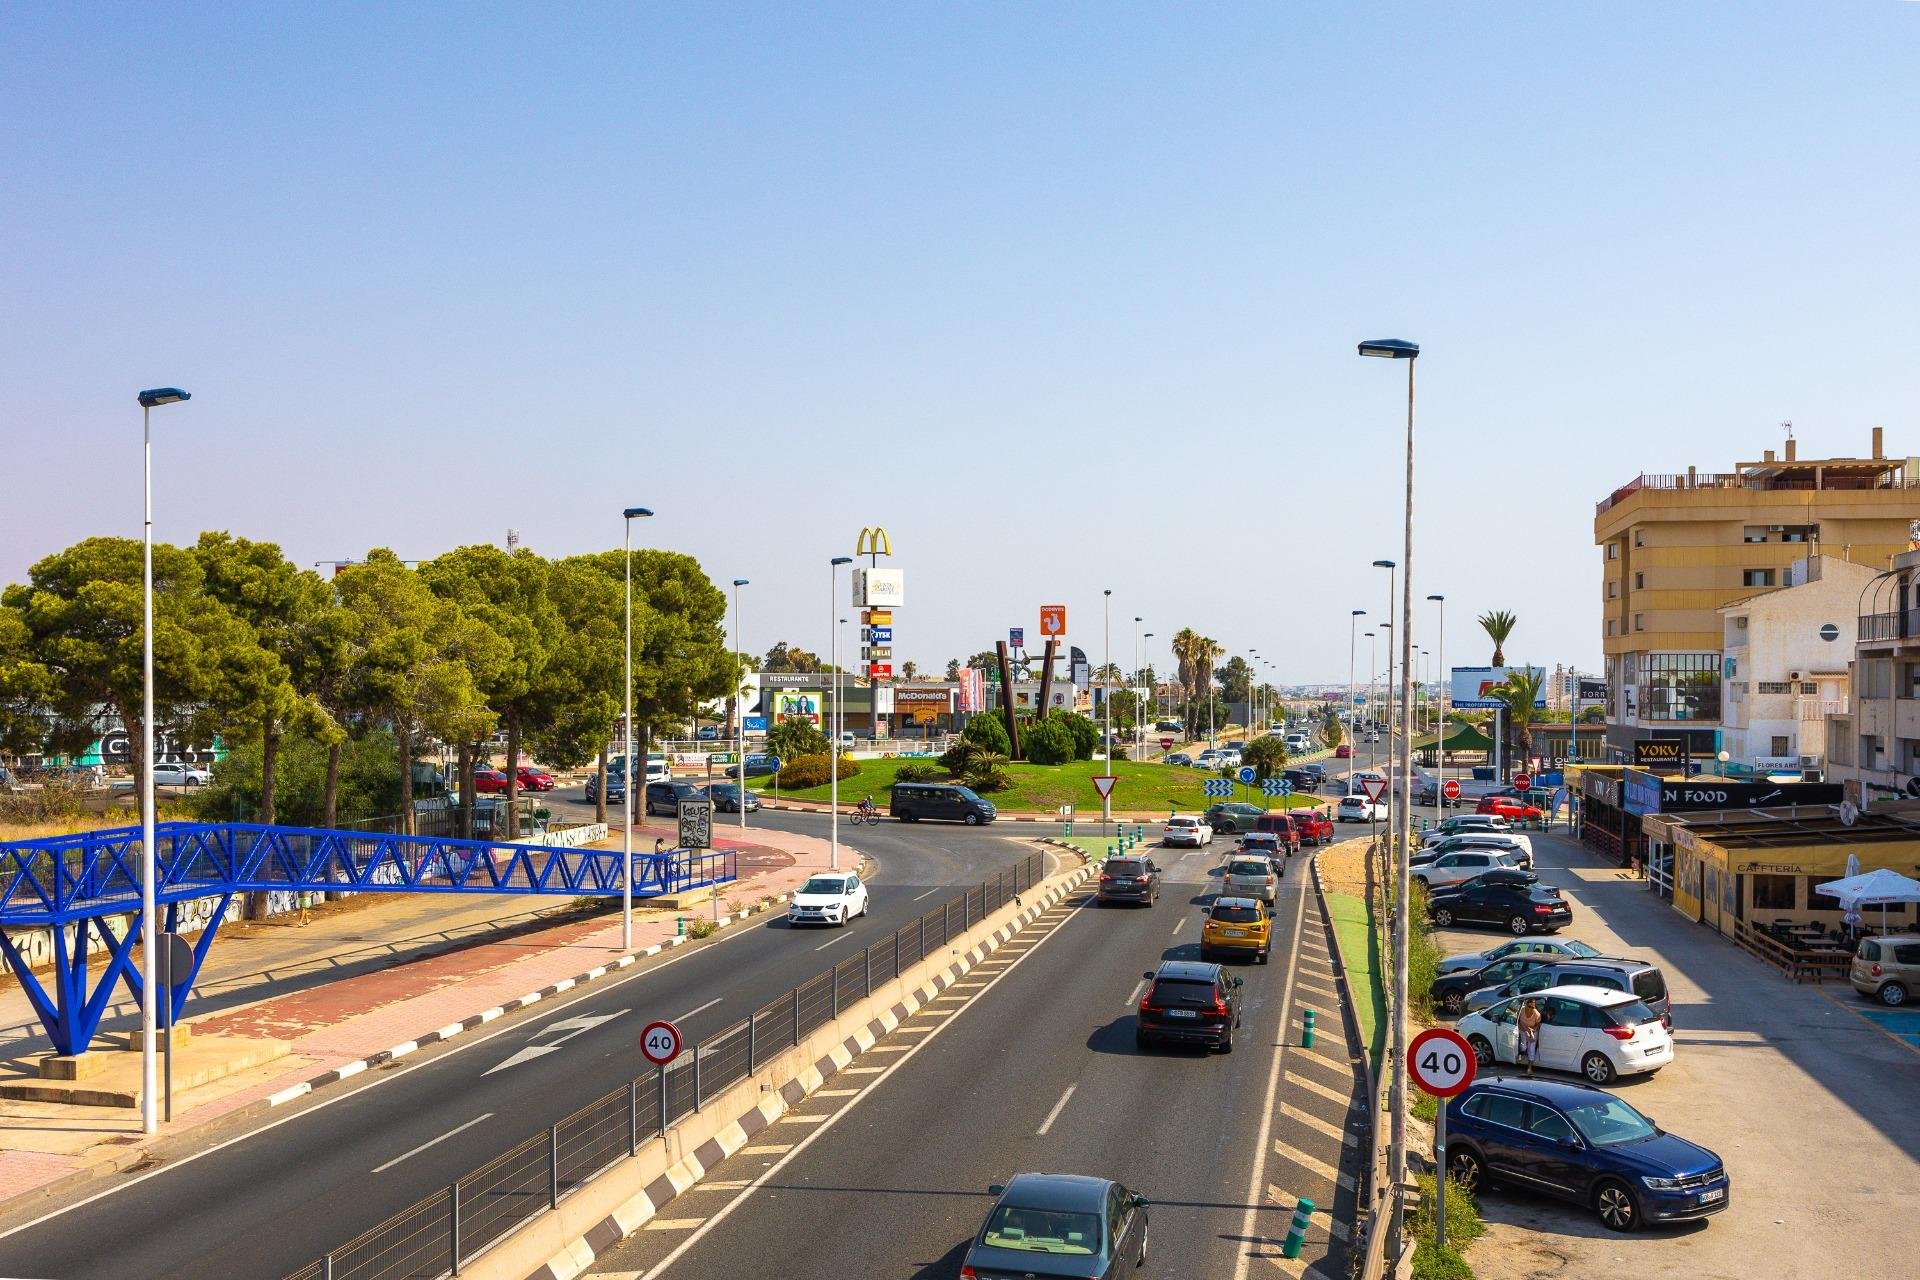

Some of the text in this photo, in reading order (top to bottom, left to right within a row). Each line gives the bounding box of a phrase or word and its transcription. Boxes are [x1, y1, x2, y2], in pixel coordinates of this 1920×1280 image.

[874, 631, 891, 639] JYSK
[898, 692, 947, 700] McDonald's
[1638, 744, 1680, 757] YOKU
[1684, 790, 1728, 803] FOOD
[648, 1035, 672, 1050] 40
[1421, 1051, 1462, 1075] 40
